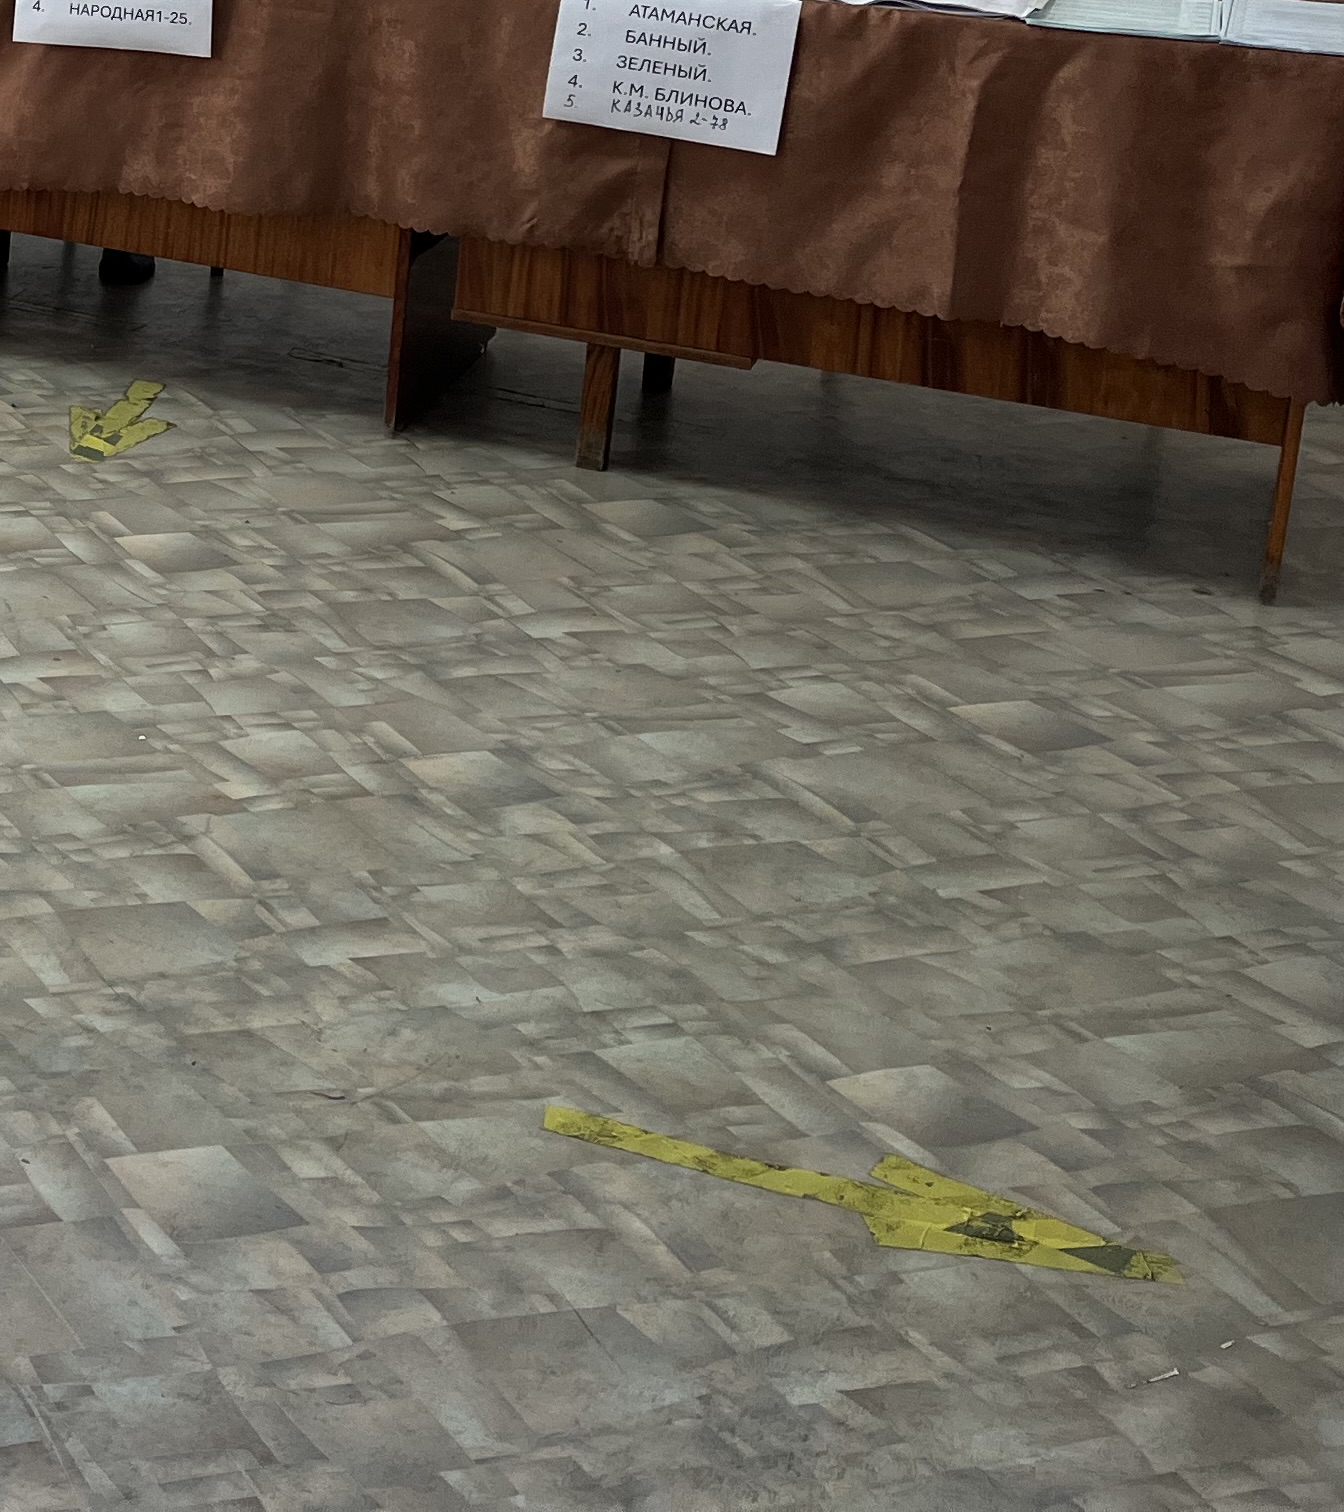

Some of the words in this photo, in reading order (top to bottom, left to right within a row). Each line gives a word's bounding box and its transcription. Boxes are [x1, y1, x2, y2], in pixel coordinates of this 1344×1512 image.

[32, 0, 46, 13] 4.
[628, 4, 758, 36] АТАМАНСКАЯ.
[576, 22, 593, 38] 2.
[624, 29, 713, 57] БАННЫЙ.
[572, 48, 588, 64] 3.
[615, 55, 713, 84] ЗЕЛЕНЫЙ.
[567, 74, 583, 89] 4.
[612, 80, 649, 100] К.М.
[654, 87, 753, 117] БЛИНОВА.
[610, 98, 685, 124] КАЗАЧЬЯ
